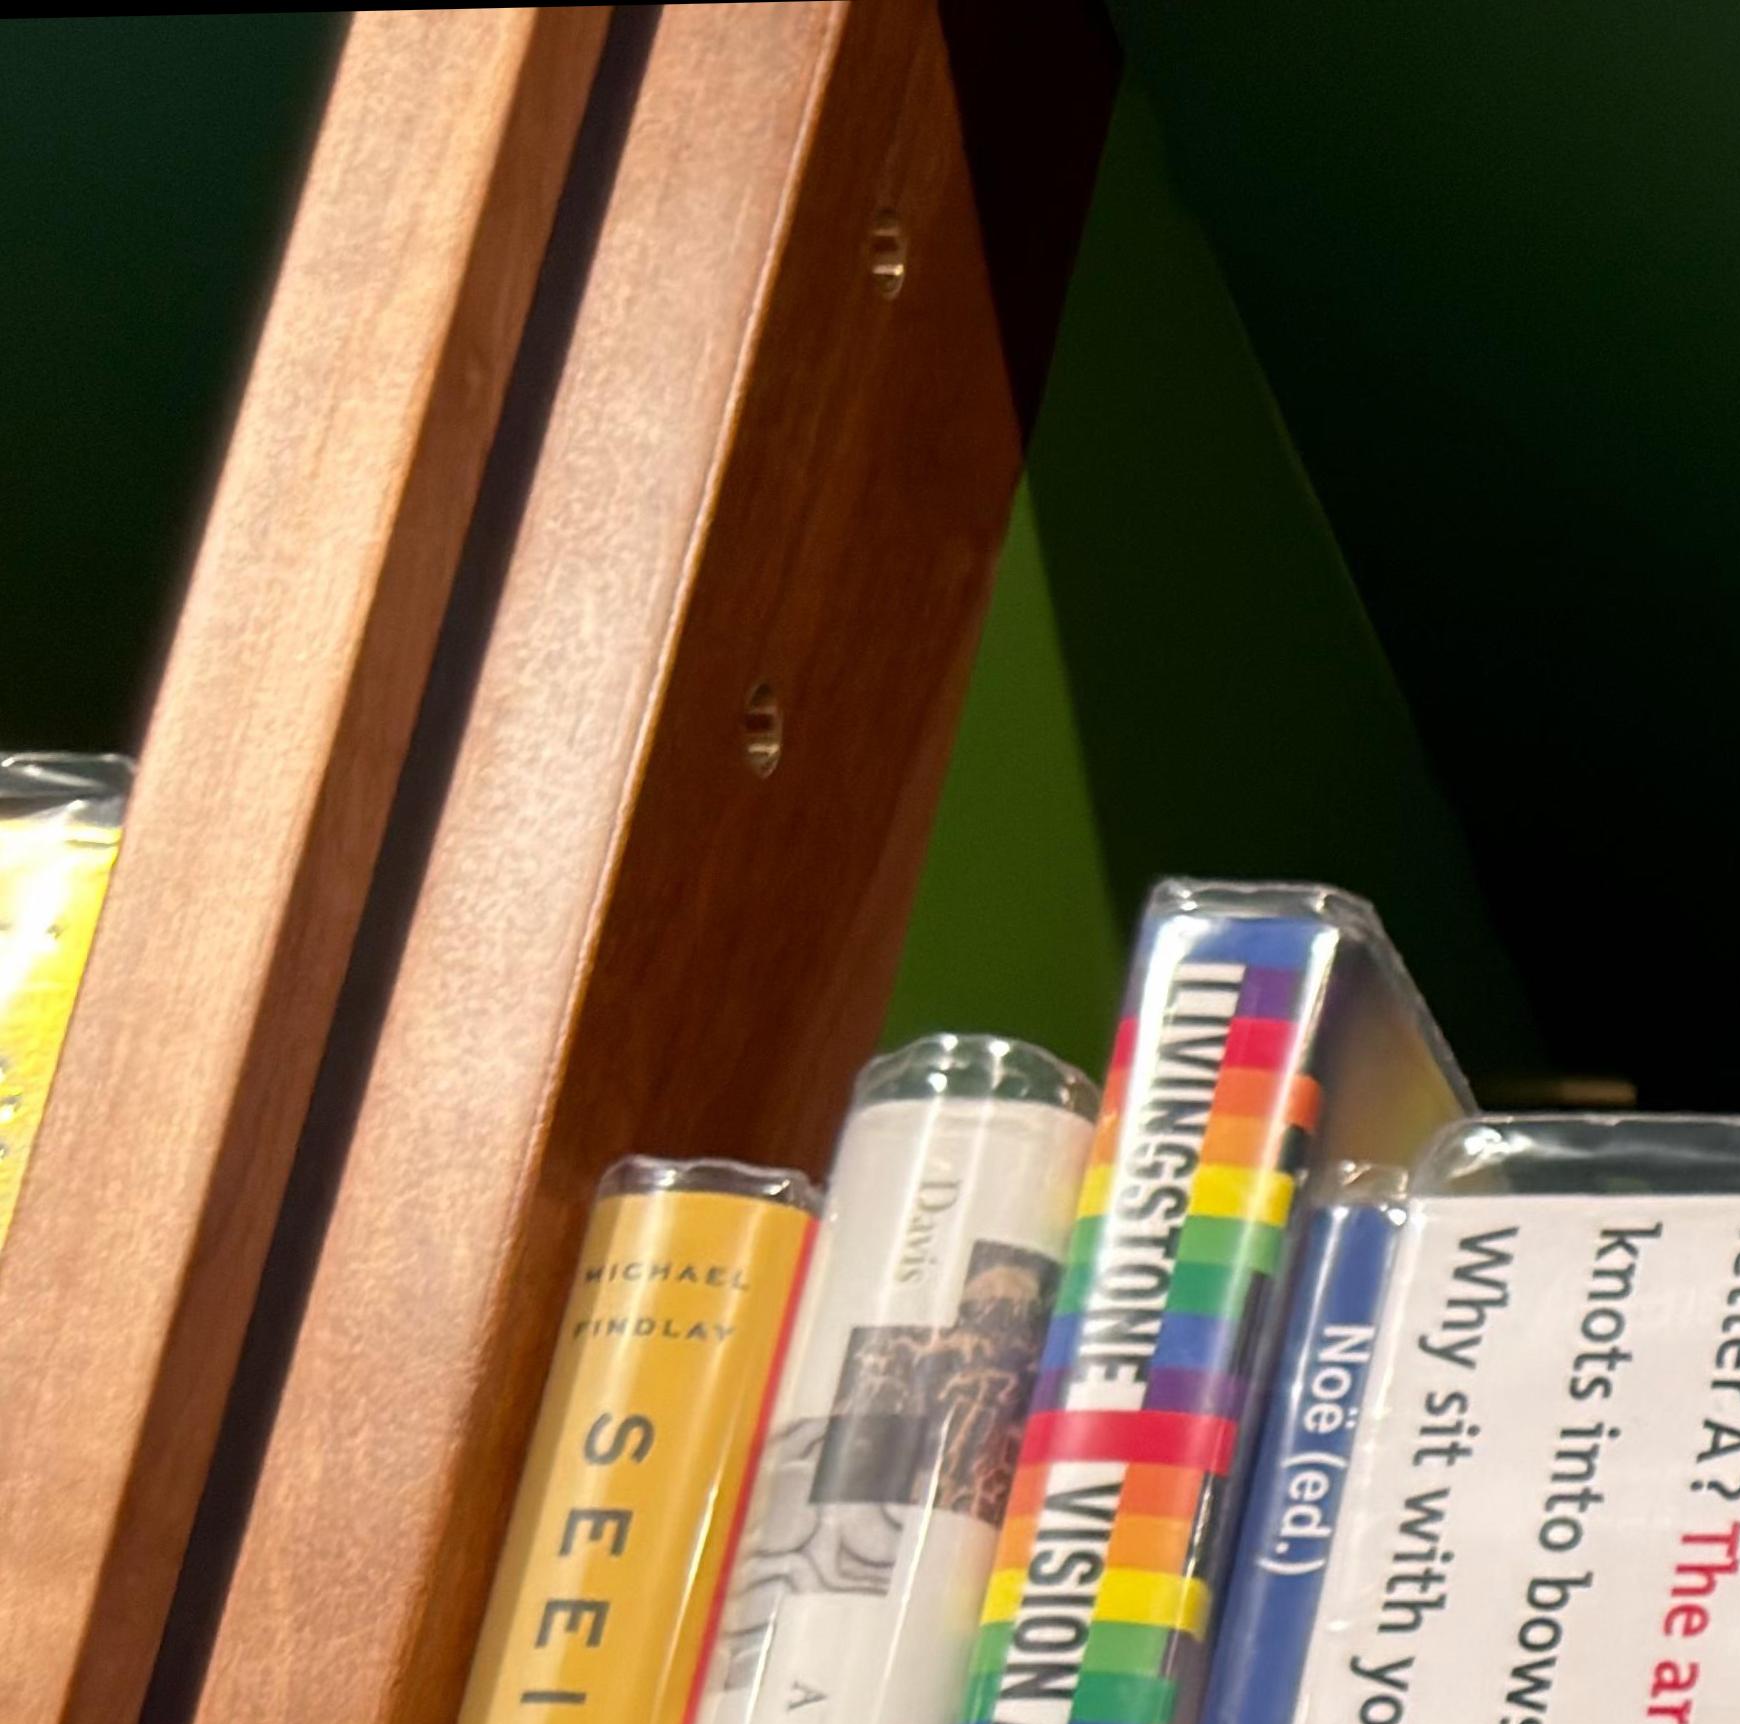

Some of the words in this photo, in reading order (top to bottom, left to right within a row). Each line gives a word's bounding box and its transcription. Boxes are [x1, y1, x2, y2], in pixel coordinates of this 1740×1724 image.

[896, 1179, 962, 1283] Davis
[1071, 962, 1245, 1412] LIVINGSTONE
[998, 1463, 1128, 1707] VISION
[786, 1683, 826, 1713] A
